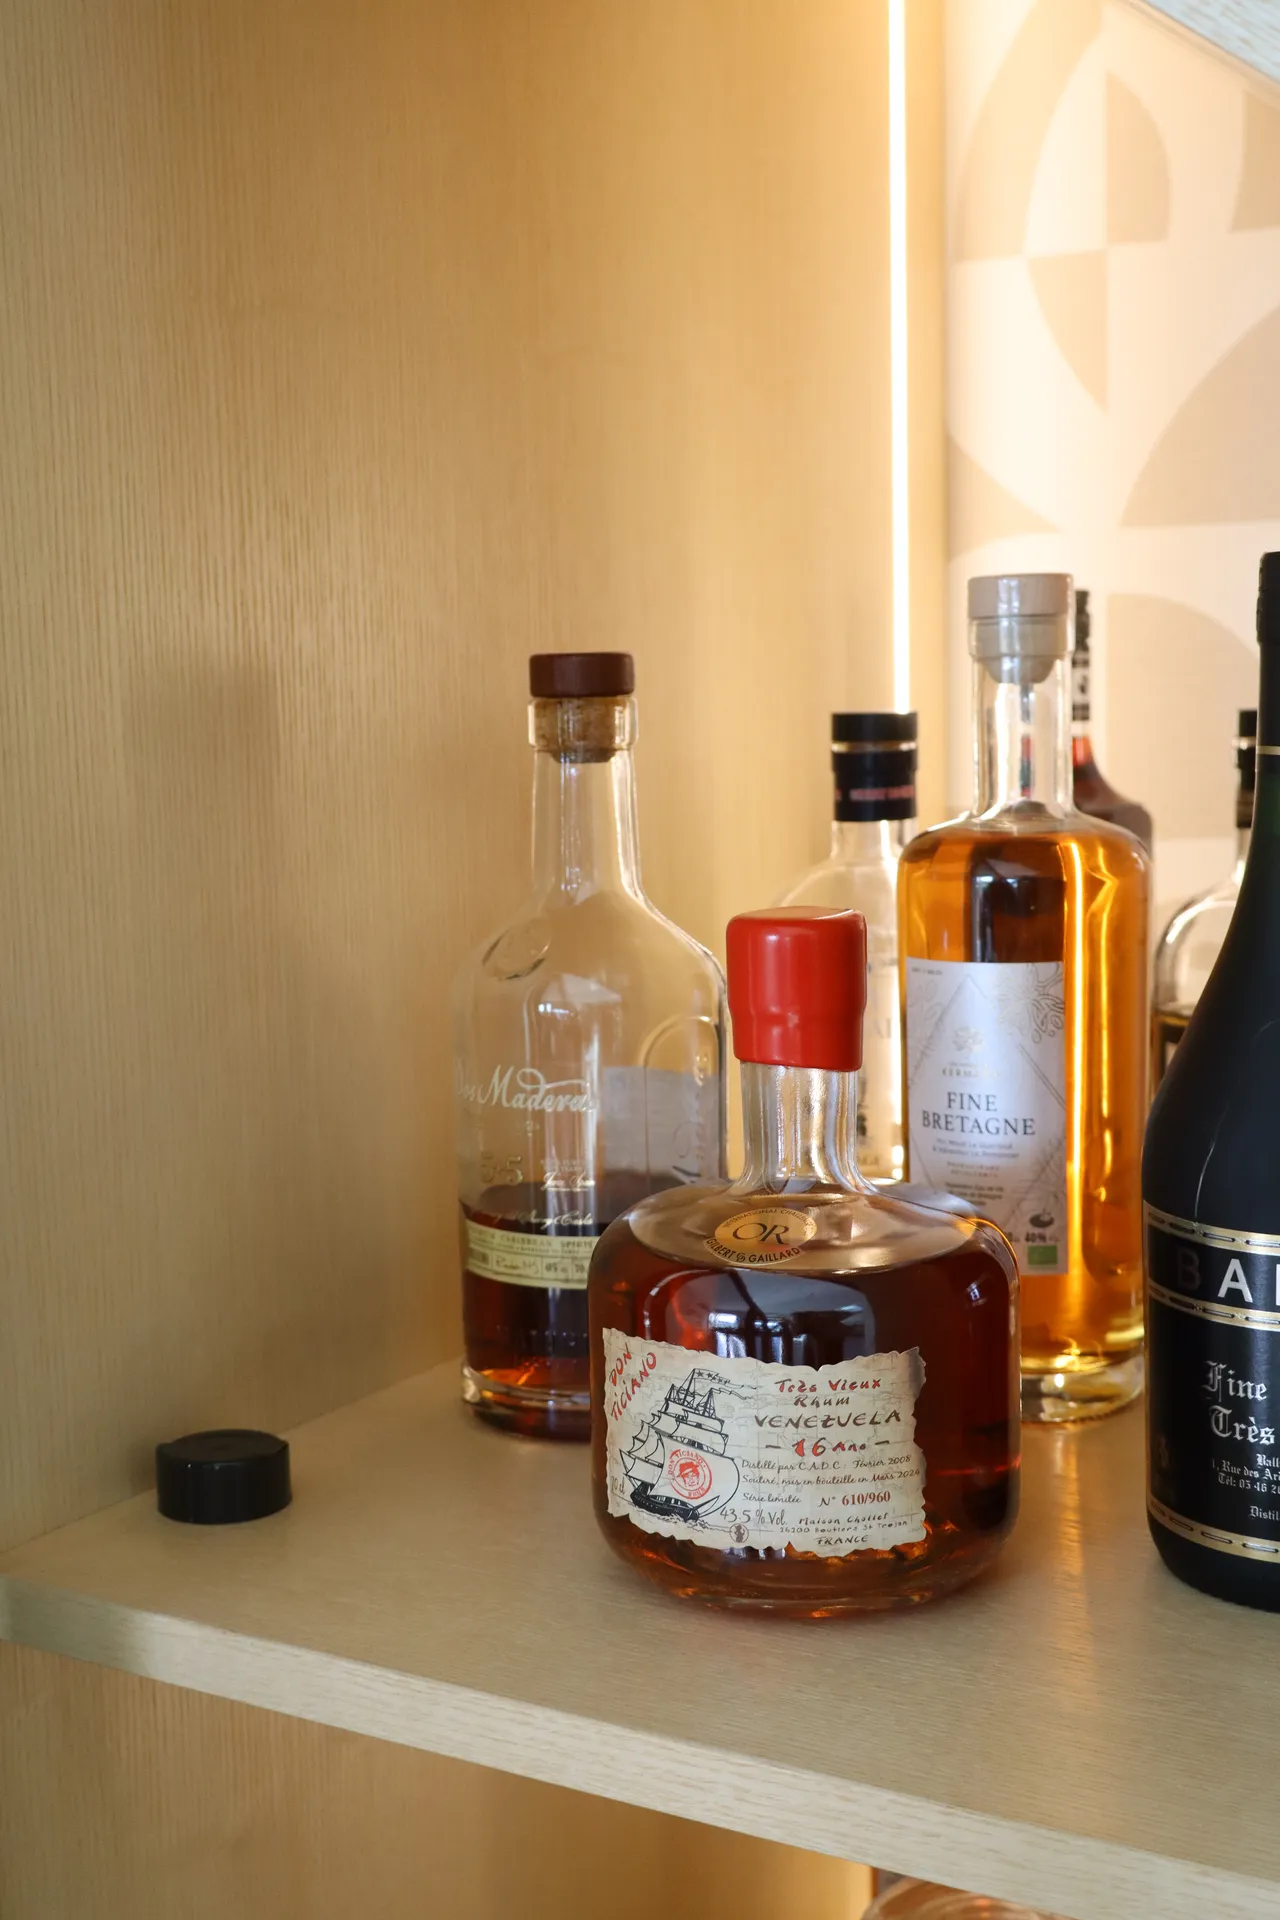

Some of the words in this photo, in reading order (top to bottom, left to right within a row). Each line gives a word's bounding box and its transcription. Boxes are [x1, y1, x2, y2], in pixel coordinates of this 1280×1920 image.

[947, 1091, 998, 1112] FINE
[922, 1110, 1036, 1136] BRETAGNE
[732, 1222, 790, 1245] OR
[706, 1238, 737, 1260] GILBERT
[748, 1247, 800, 1263] GAILLARD
[609, 1342, 632, 1387] DON
[829, 1378, 882, 1391] Vieux
[1201, 1360, 1268, 1402] Fine
[794, 1395, 850, 1408] Rhum
[754, 1409, 901, 1429] VENEZUELA
[1210, 1405, 1276, 1446] Très
[791, 1437, 826, 1457] 16
[741, 1459, 776, 1471] Distillé
[777, 1464, 797, 1475] par
[853, 1458, 885, 1469] Février
[888, 1454, 911, 1465] 2008
[1222, 1460, 1241, 1475] Rue
[1243, 1465, 1260, 1478] des
[816, 1473, 856, 1485] bouteille
[857, 1476, 868, 1484] en
[869, 1472, 895, 1482] Mars
[742, 1492, 766, 1502] Série
[767, 1493, 802, 1504] limitée
[817, 1495, 836, 1508] N°
[842, 1490, 891, 1506] 610/960
[720, 1506, 751, 1524] 43.5
[755, 1509, 766, 1525] %
[799, 1517, 841, 1526] Maison
[815, 1535, 869, 1546] FRANCE
